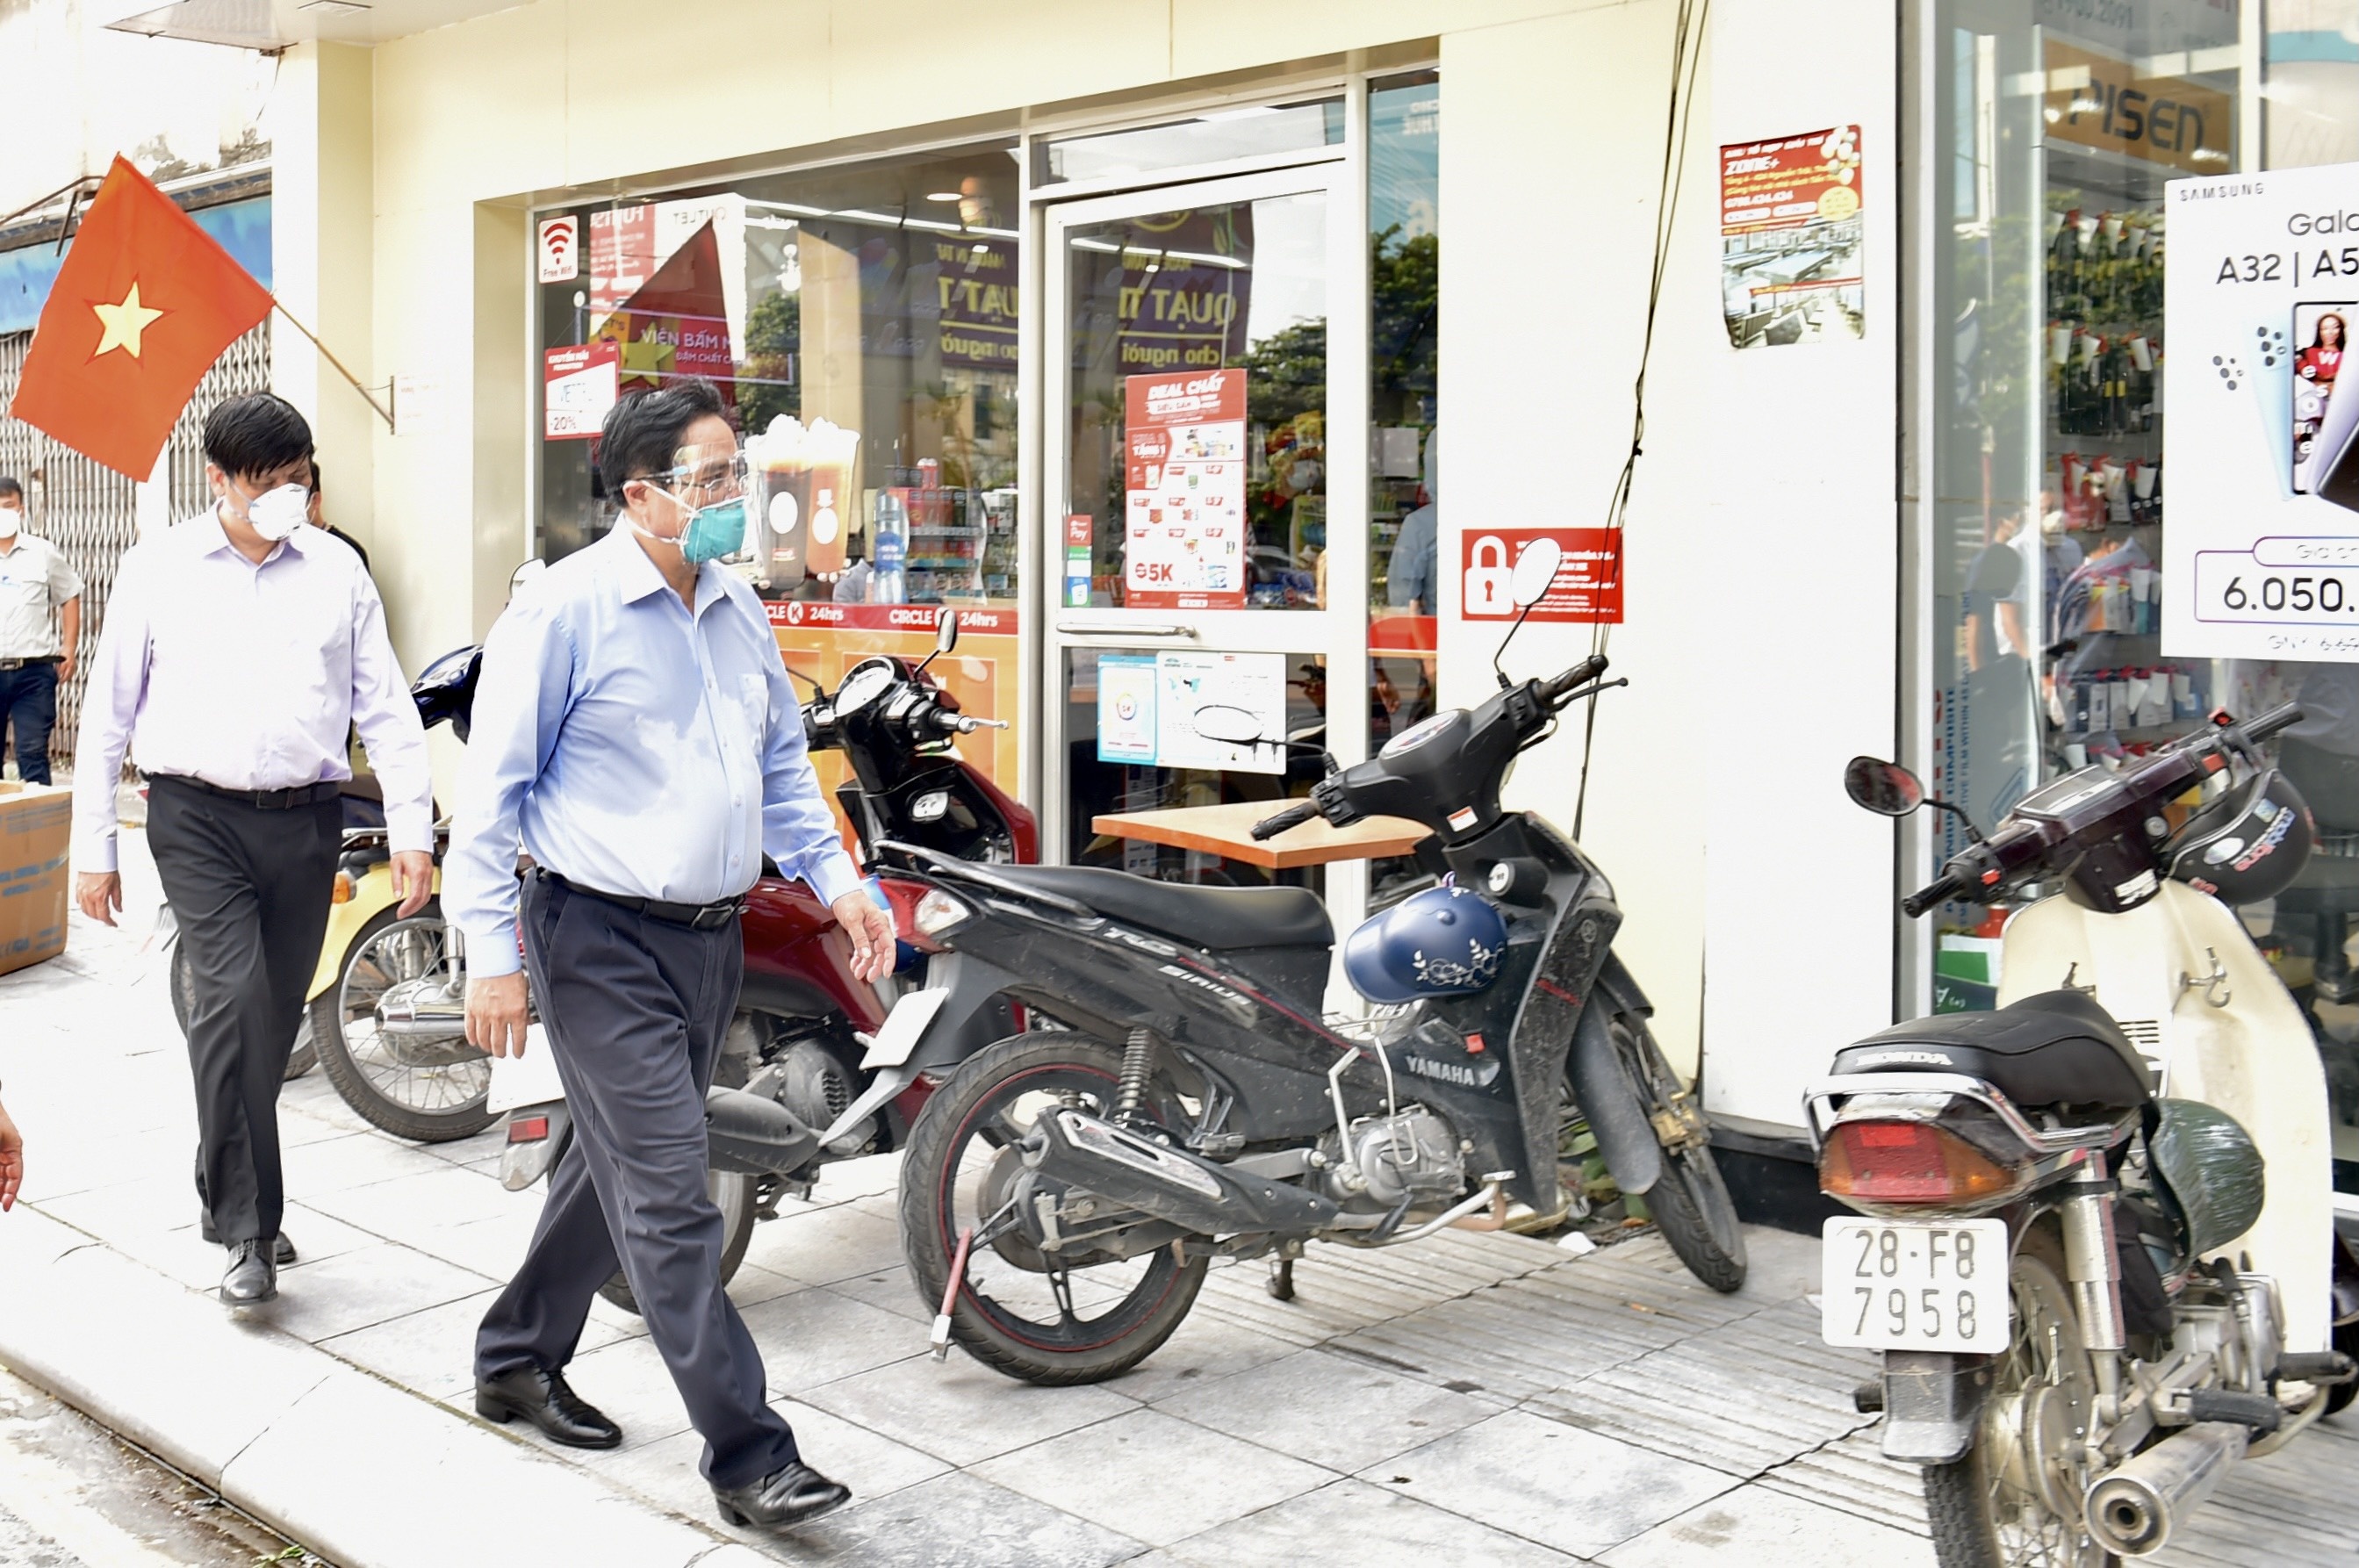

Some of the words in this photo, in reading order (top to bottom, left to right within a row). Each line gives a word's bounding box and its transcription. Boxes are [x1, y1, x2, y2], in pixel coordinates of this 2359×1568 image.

[2068, 77, 2204, 154] PISEN
[2179, 183, 2264, 201] SAMSUNG
[2215, 254, 2281, 284] A32
[809, 607, 844, 621] 24hrs
[888, 609, 932, 625] CIRCLE
[960, 612, 998, 628] 24hrs
[1405, 1055, 1476, 1087] YAMAHA
[1853, 1287, 1976, 1340] 7958
